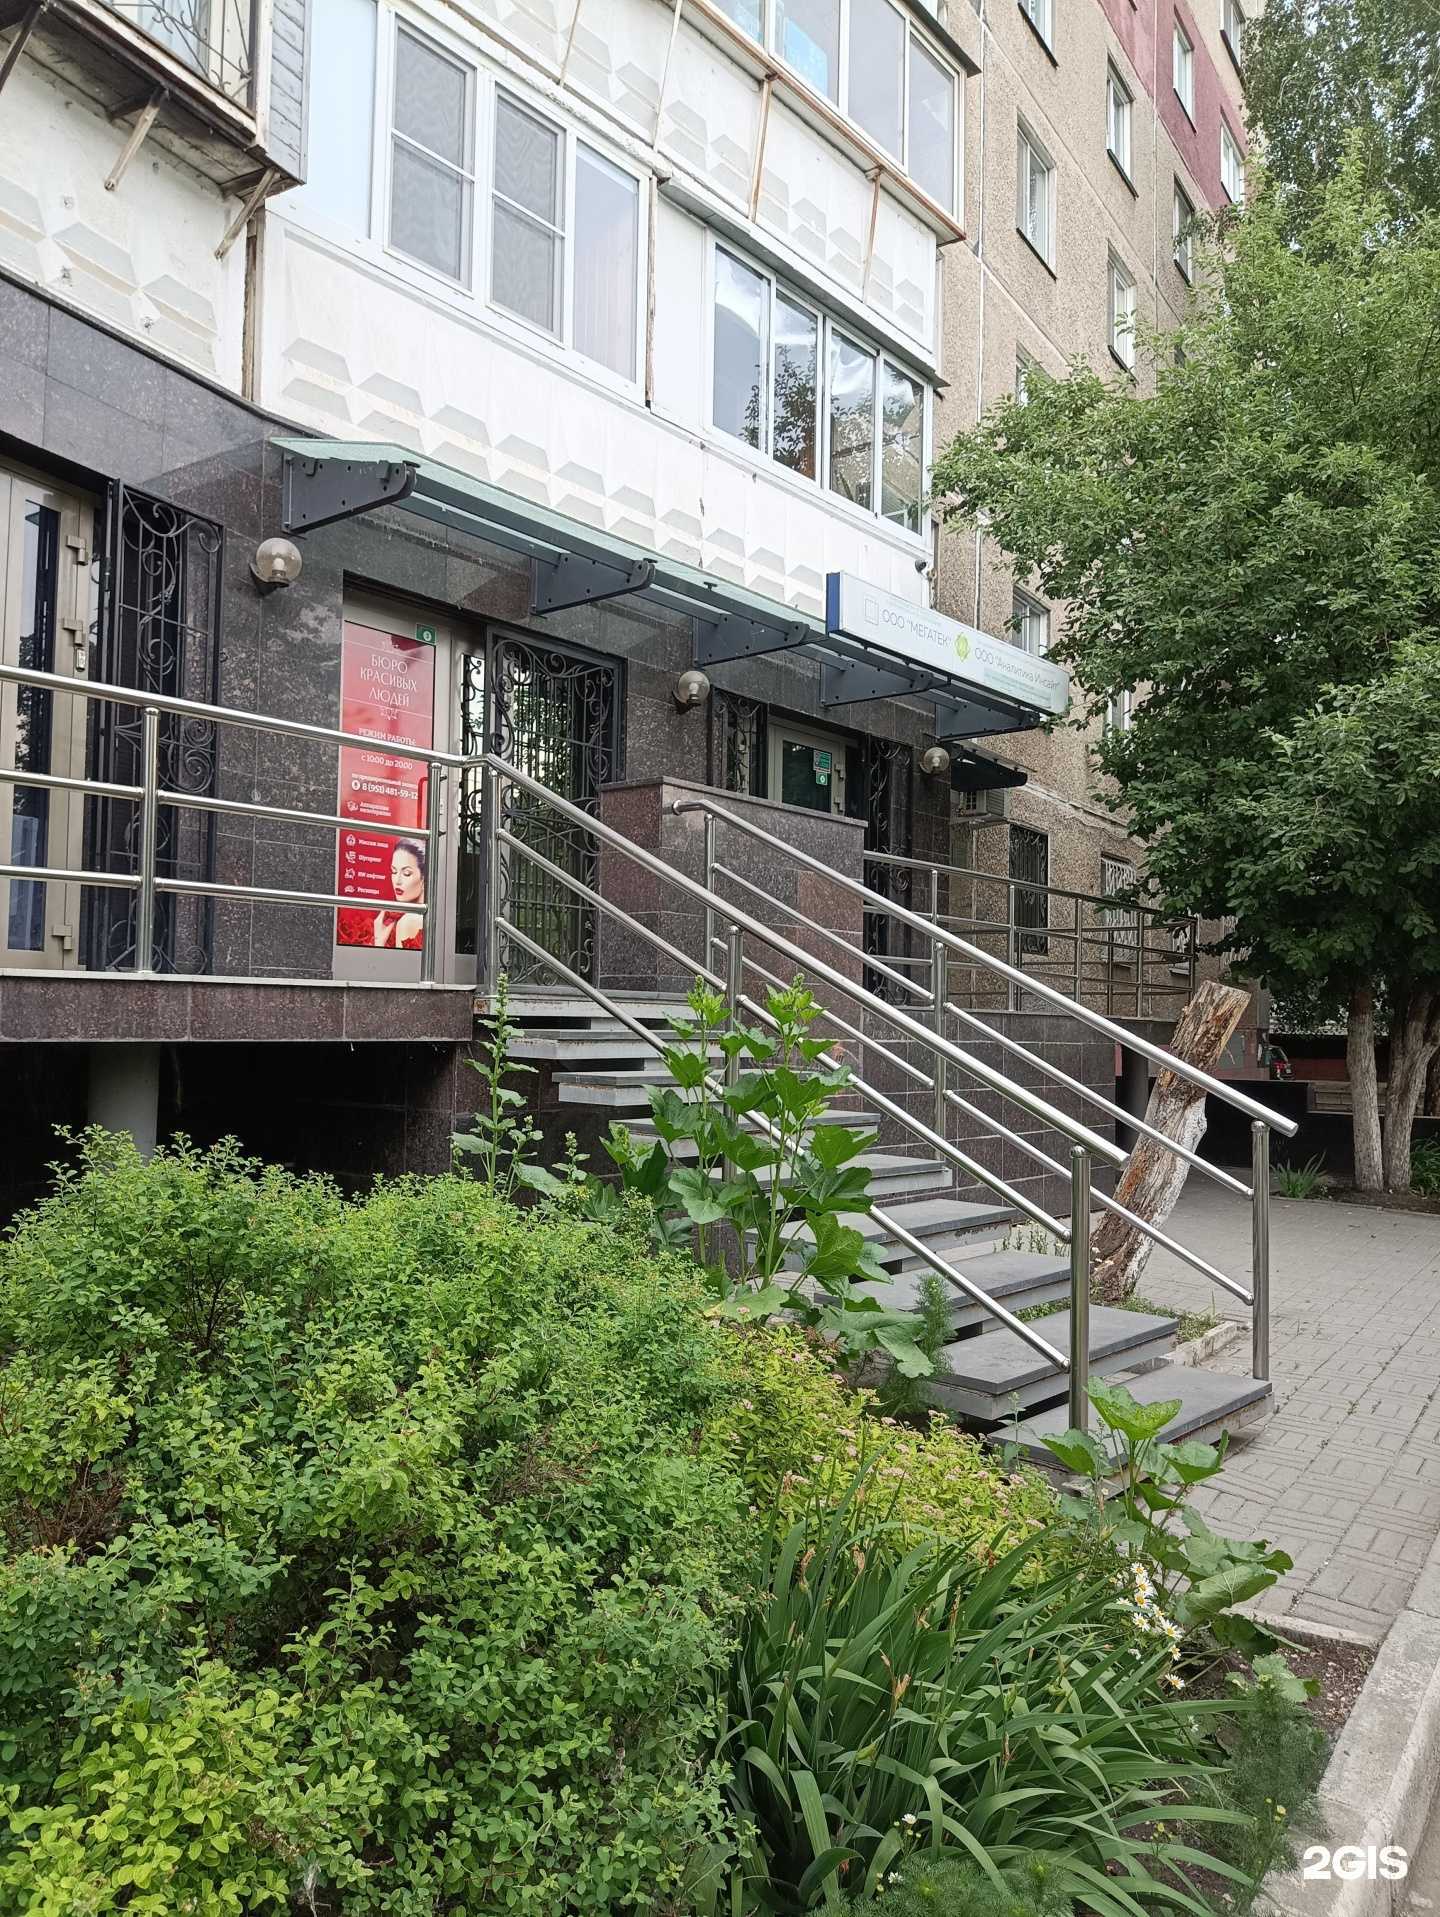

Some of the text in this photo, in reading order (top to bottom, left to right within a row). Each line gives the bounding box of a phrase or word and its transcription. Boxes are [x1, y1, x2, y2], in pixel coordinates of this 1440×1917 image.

[881, 609, 905, 629] ООО
[371, 654, 408, 674] БЮРО
[973, 647, 995, 665] ООО
[360, 666, 417, 692] КРАСИВЫХ
[368, 687, 409, 707] ЛЮДЕЙ
[362, 783, 367, 791] 8
